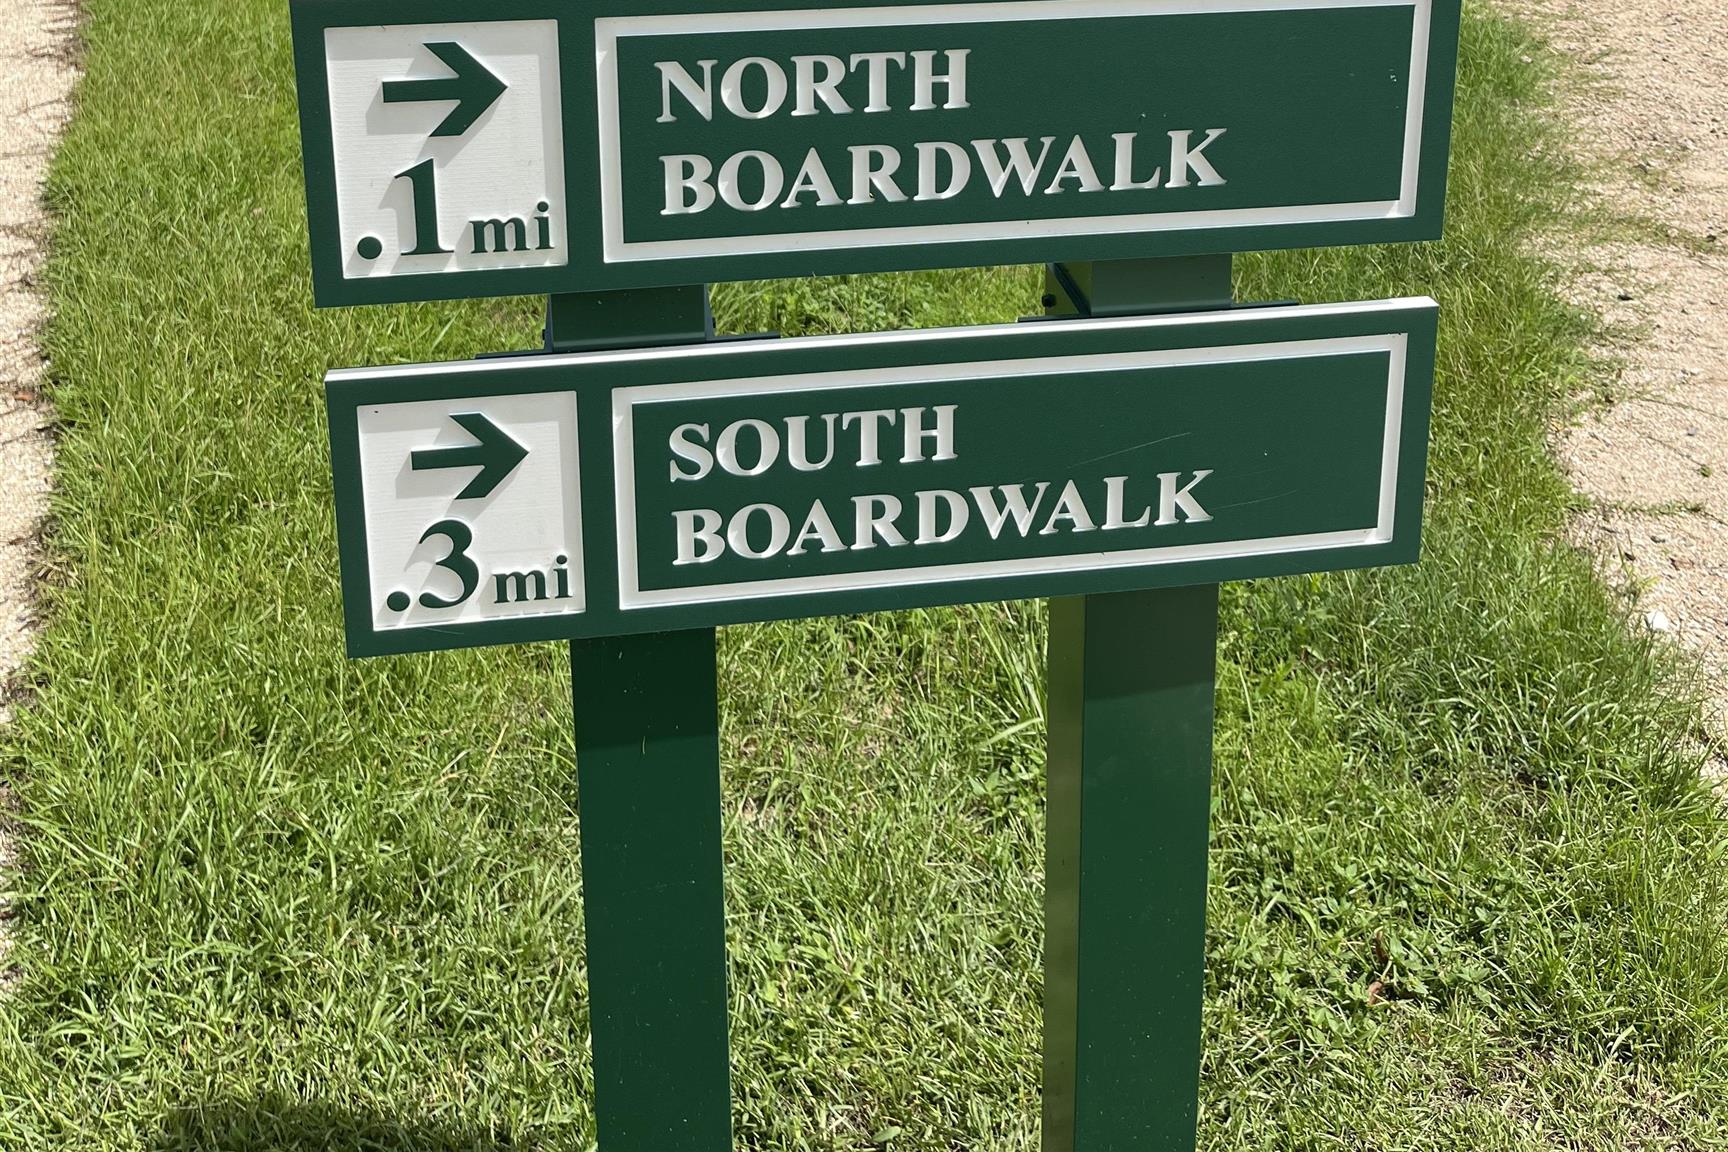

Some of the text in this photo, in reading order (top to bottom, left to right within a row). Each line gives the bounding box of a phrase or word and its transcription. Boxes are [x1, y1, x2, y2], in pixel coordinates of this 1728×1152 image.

[656, 49, 971, 122] NORTH
[358, 158, 553, 260] .1 mi
[660, 128, 1227, 217] BOARDWALK
[668, 404, 958, 483] SOUTH
[671, 469, 1214, 567] BOARDWALK
[387, 520, 572, 612] .3 mi
